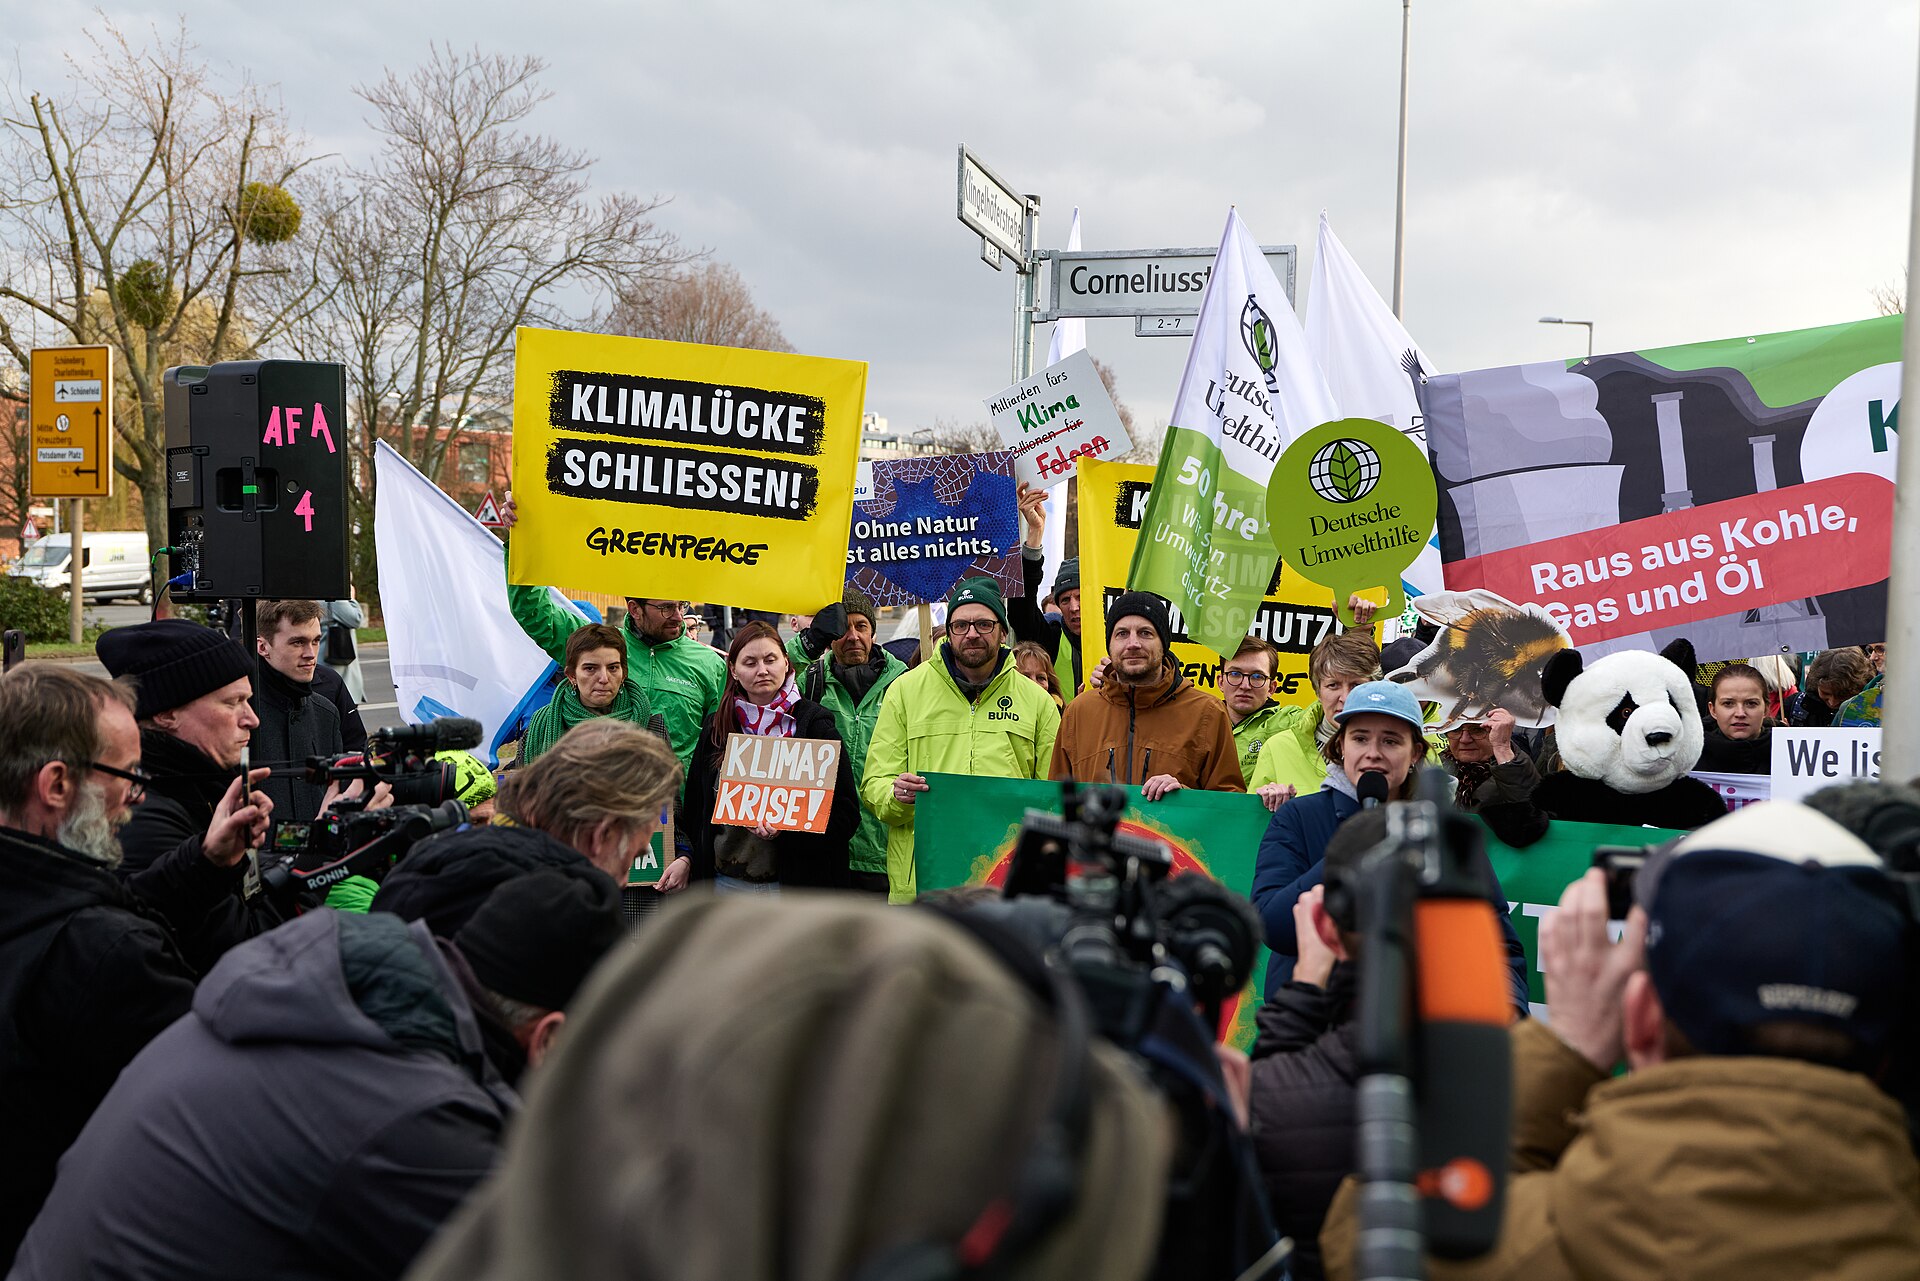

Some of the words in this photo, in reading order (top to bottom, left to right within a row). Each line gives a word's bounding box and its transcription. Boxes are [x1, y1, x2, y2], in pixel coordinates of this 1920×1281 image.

[54, 368, 93, 377] Charlottenburg
[70, 384, 99, 395] Schönefeld
[991, 384, 1041, 416] Milliarden
[1046, 371, 1068, 387] fürs
[37, 424, 53, 432] Mitte
[571, 384, 807, 444] KLIMALÜCKE
[1017, 394, 1080, 433] Klima
[37, 436, 72, 445] Kreuzberg
[39, 450, 66, 460] Potsdamer
[68, 450, 81, 460] Platz
[1009, 430, 1056, 460] Billionen
[1064, 418, 1082, 433] für
[563, 449, 802, 509] SCHLIESSEN!
[853, 486, 867, 495] BU
[1177, 455, 1211, 498] 50
[293, 490, 315, 532] 4
[855, 520, 912, 539] Ohne
[917, 516, 979, 534] Natur
[1309, 502, 1401, 537] Deutsche
[586, 526, 768, 565] GREENPEACE
[846, 546, 866, 564] st
[870, 542, 920, 562] alles
[925, 537, 998, 558] nichts.
[1299, 524, 1420, 567] Umwelthilfe
[1530, 551, 1634, 595] Raus
[1640, 533, 1714, 571] aus
[1720, 503, 1859, 553] Kohle,
[1181, 570, 1205, 607] durc
[1542, 598, 1620, 630] Gas
[1626, 570, 1708, 616] und
[1715, 554, 1765, 596] Öl
[988, 711, 1020, 722] BUND
[726, 736, 836, 787] KLIMA?
[1787, 739, 1839, 777] We
[715, 782, 826, 830] KRISE!
[307, 866, 350, 890] RONIN
